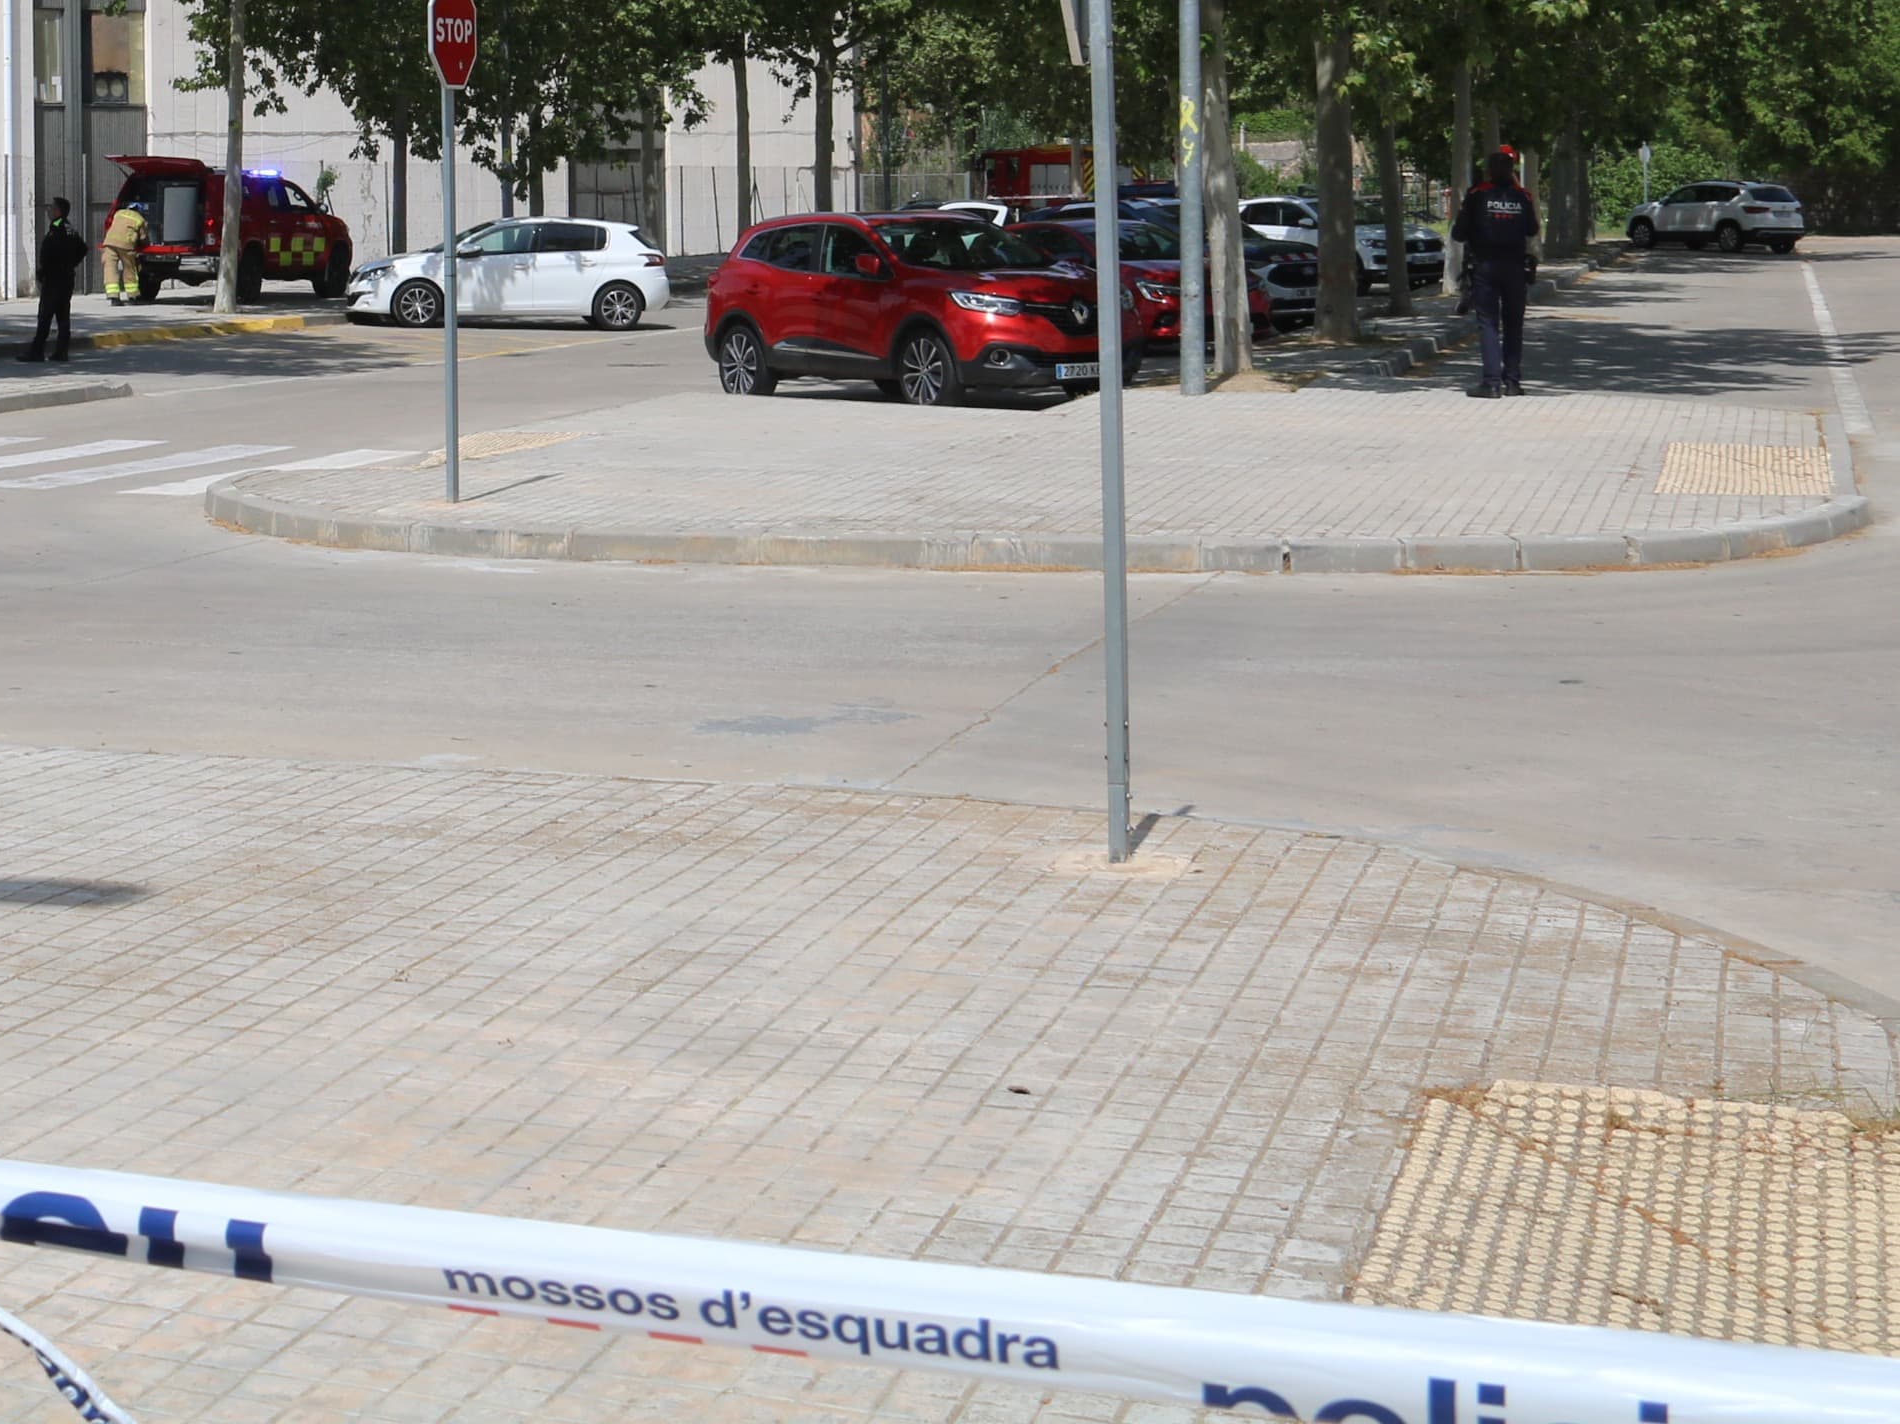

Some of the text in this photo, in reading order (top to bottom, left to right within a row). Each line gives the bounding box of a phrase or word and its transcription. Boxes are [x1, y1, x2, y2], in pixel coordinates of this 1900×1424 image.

[436, 17, 473, 44] STOP
[1486, 200, 1523, 210] POLICIA
[1064, 365, 1088, 377] 2720
[442, 1268, 1061, 1371] mossos d'esquadra
